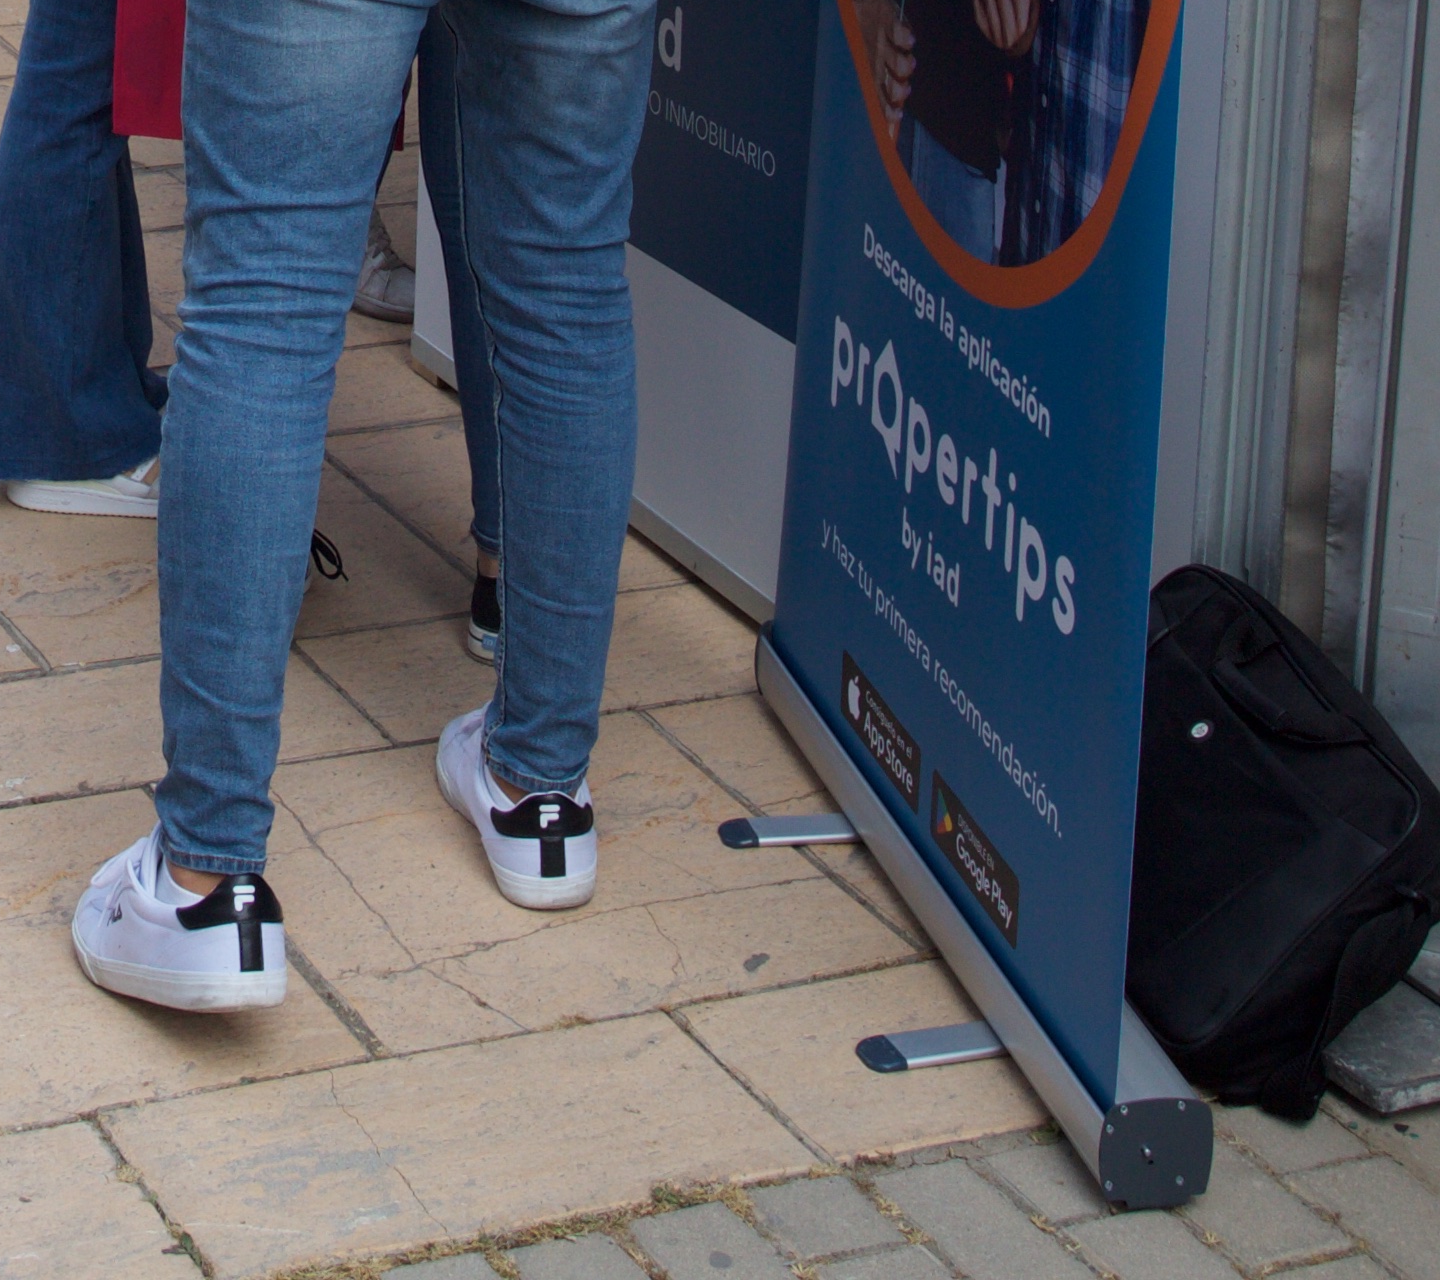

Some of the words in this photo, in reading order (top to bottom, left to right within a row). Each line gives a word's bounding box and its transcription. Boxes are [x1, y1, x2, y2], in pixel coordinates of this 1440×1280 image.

[665, 97, 776, 177] INMOBILIARIO
[864, 222, 935, 324] Descarga
[940, 296, 955, 342] la
[958, 324, 1052, 438] aplicación
[902, 506, 922, 570] by
[926, 532, 961, 608] iad
[822, 518, 831, 549] y
[832, 525, 855, 579] haz
[858, 559, 873, 599] tu
[875, 585, 930, 672] primera
[934, 657, 1063, 838] recomendación.
[864, 711, 886, 759] App
[884, 743, 914, 794] Store
[896, 731, 906, 750] en
[906, 741, 914, 760] el
[955, 832, 991, 896] Google
[991, 883, 1013, 930] Play
